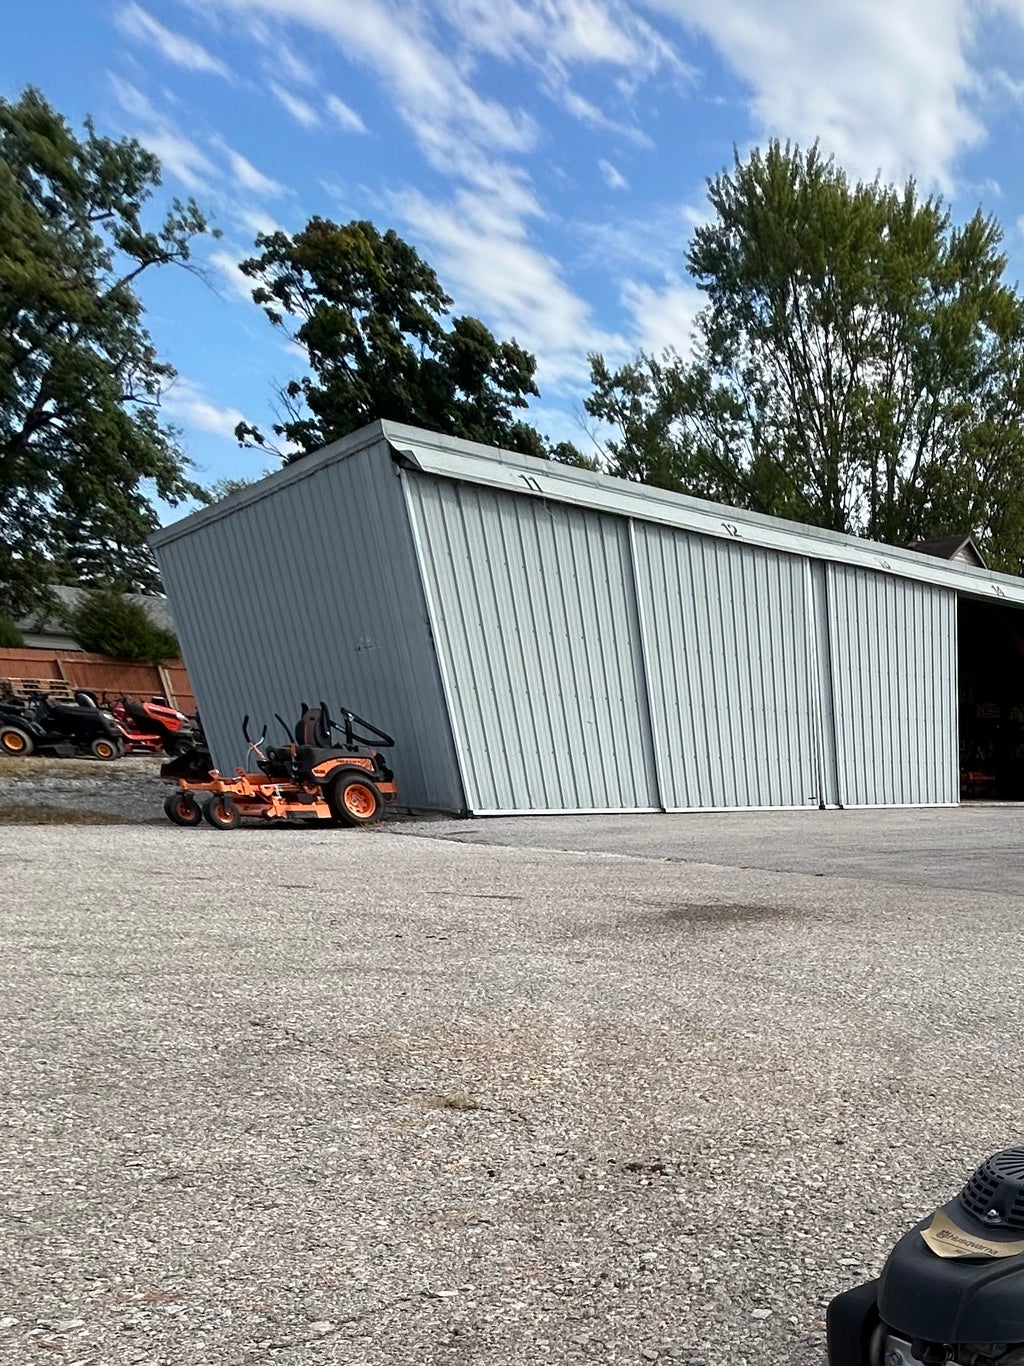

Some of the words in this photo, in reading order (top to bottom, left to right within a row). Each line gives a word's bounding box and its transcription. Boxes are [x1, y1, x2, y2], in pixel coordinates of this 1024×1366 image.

[518, 474, 543, 492] 11
[721, 522, 742, 538] 12
[948, 1232, 999, 1256] Husqvarna
